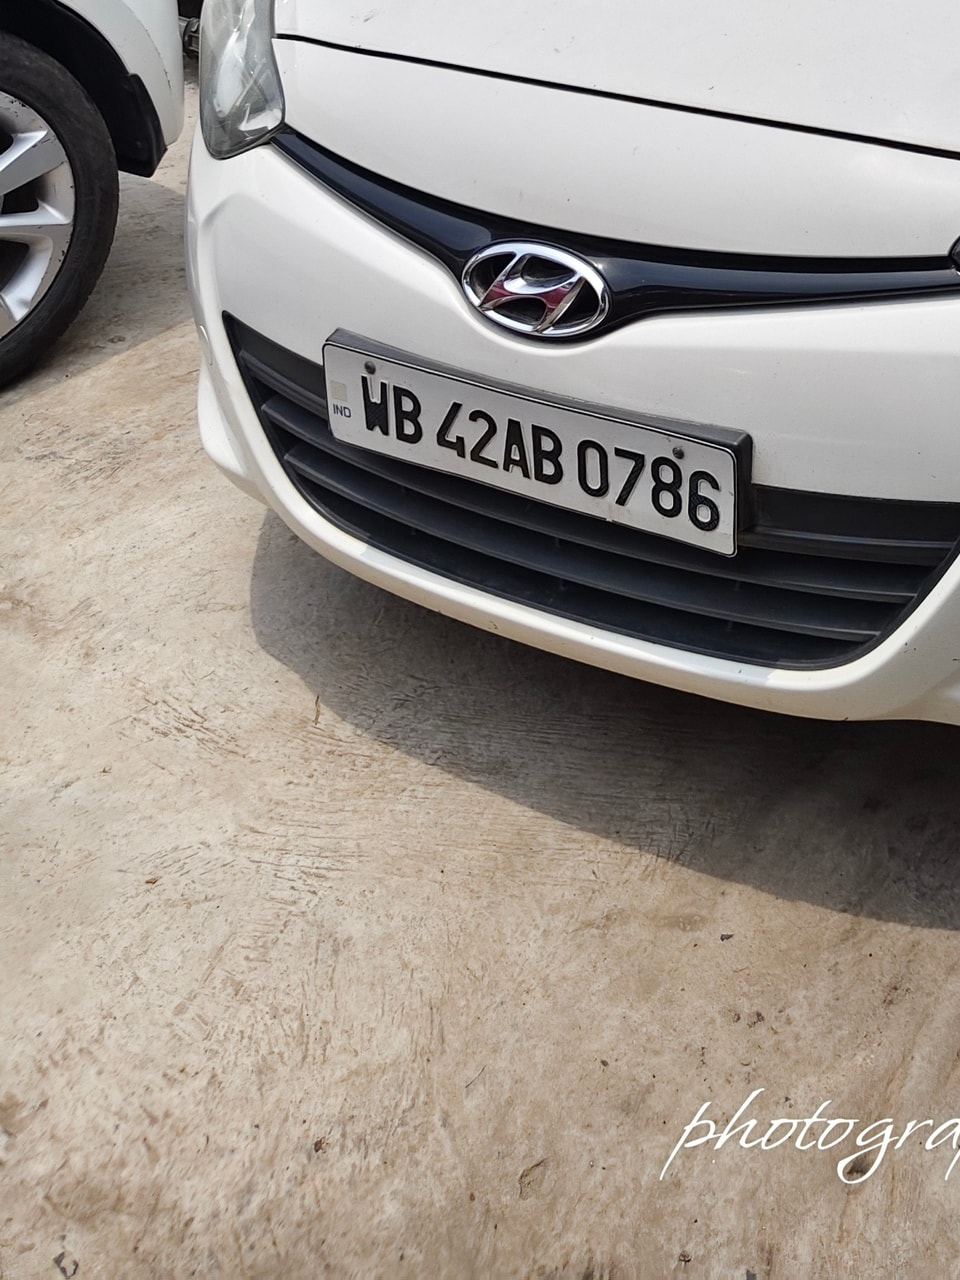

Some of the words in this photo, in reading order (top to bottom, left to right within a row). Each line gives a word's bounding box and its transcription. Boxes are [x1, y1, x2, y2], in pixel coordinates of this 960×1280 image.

[332, 403, 352, 419] IND
[360, 375, 424, 444] WB
[436, 402, 564, 486] 42AB
[577, 440, 721, 532] 0786
